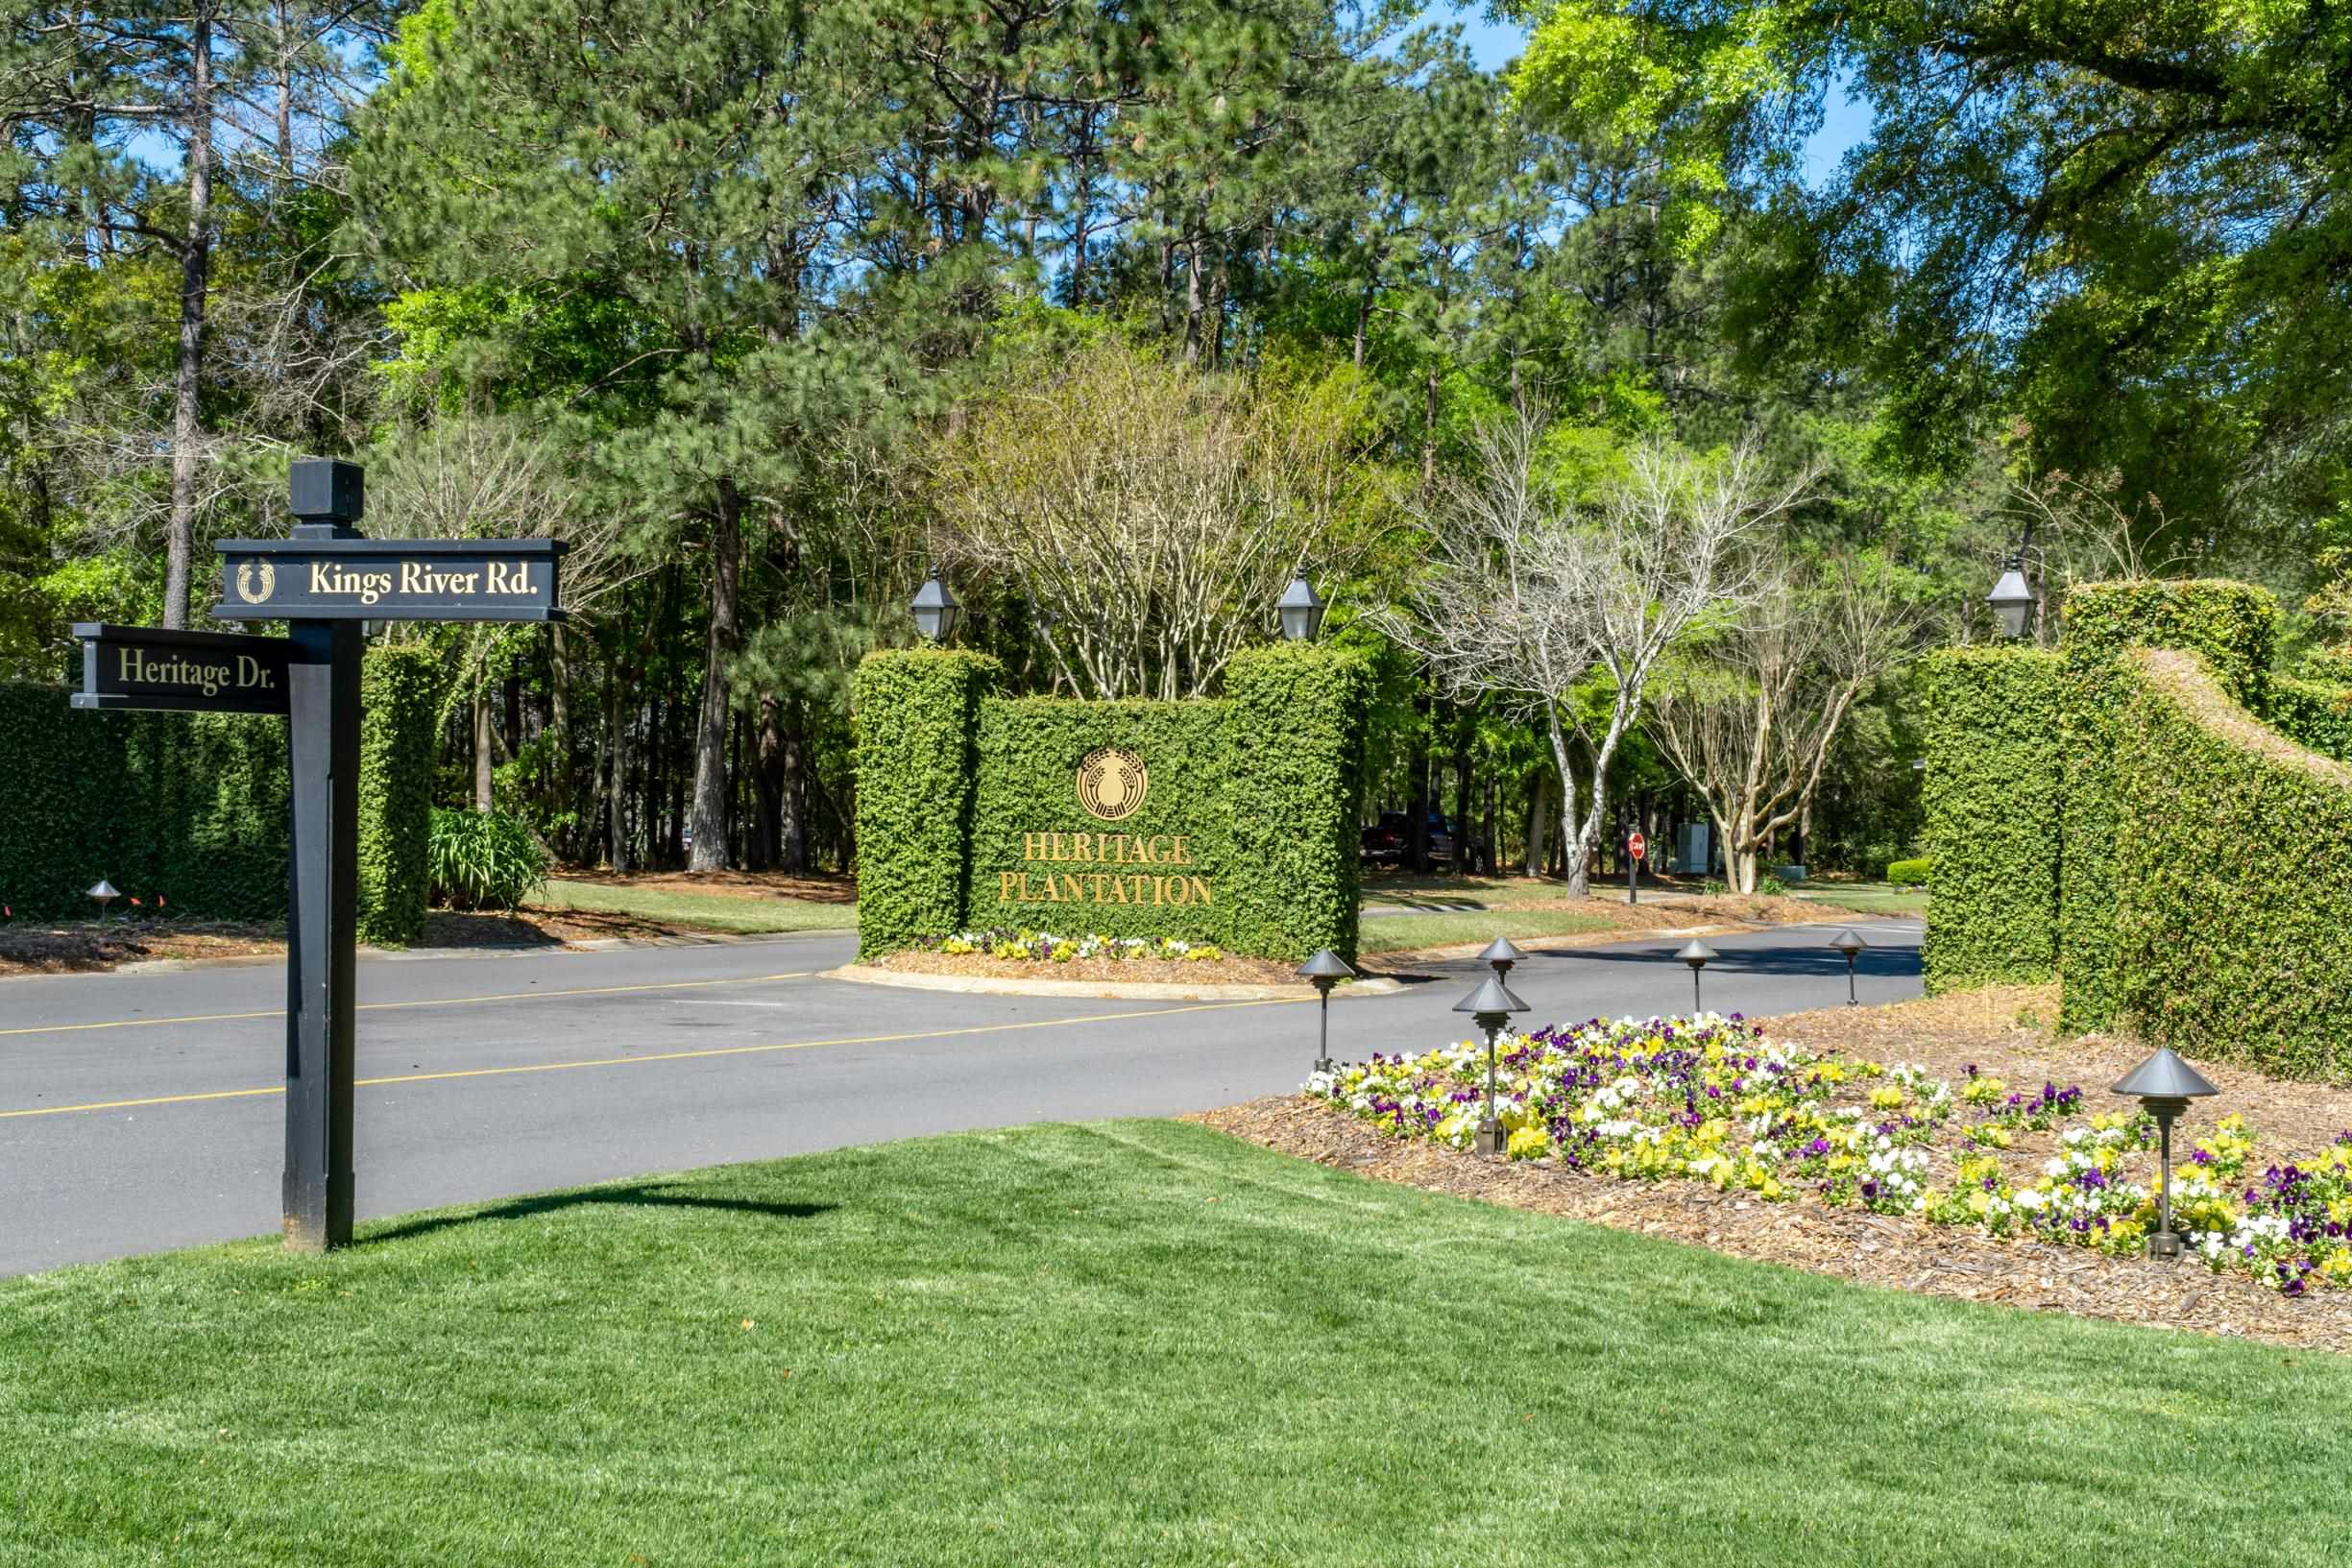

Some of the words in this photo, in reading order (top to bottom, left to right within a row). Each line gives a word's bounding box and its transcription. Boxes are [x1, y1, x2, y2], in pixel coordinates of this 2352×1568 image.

[308, 562, 392, 604] Kings
[399, 562, 479, 594] River
[485, 562, 539, 595] Rd.
[117, 647, 230, 697] Heritage
[235, 655, 276, 688] Dr.
[1023, 832, 1192, 865] HERITAGE
[998, 871, 1214, 906] PLANTATION
